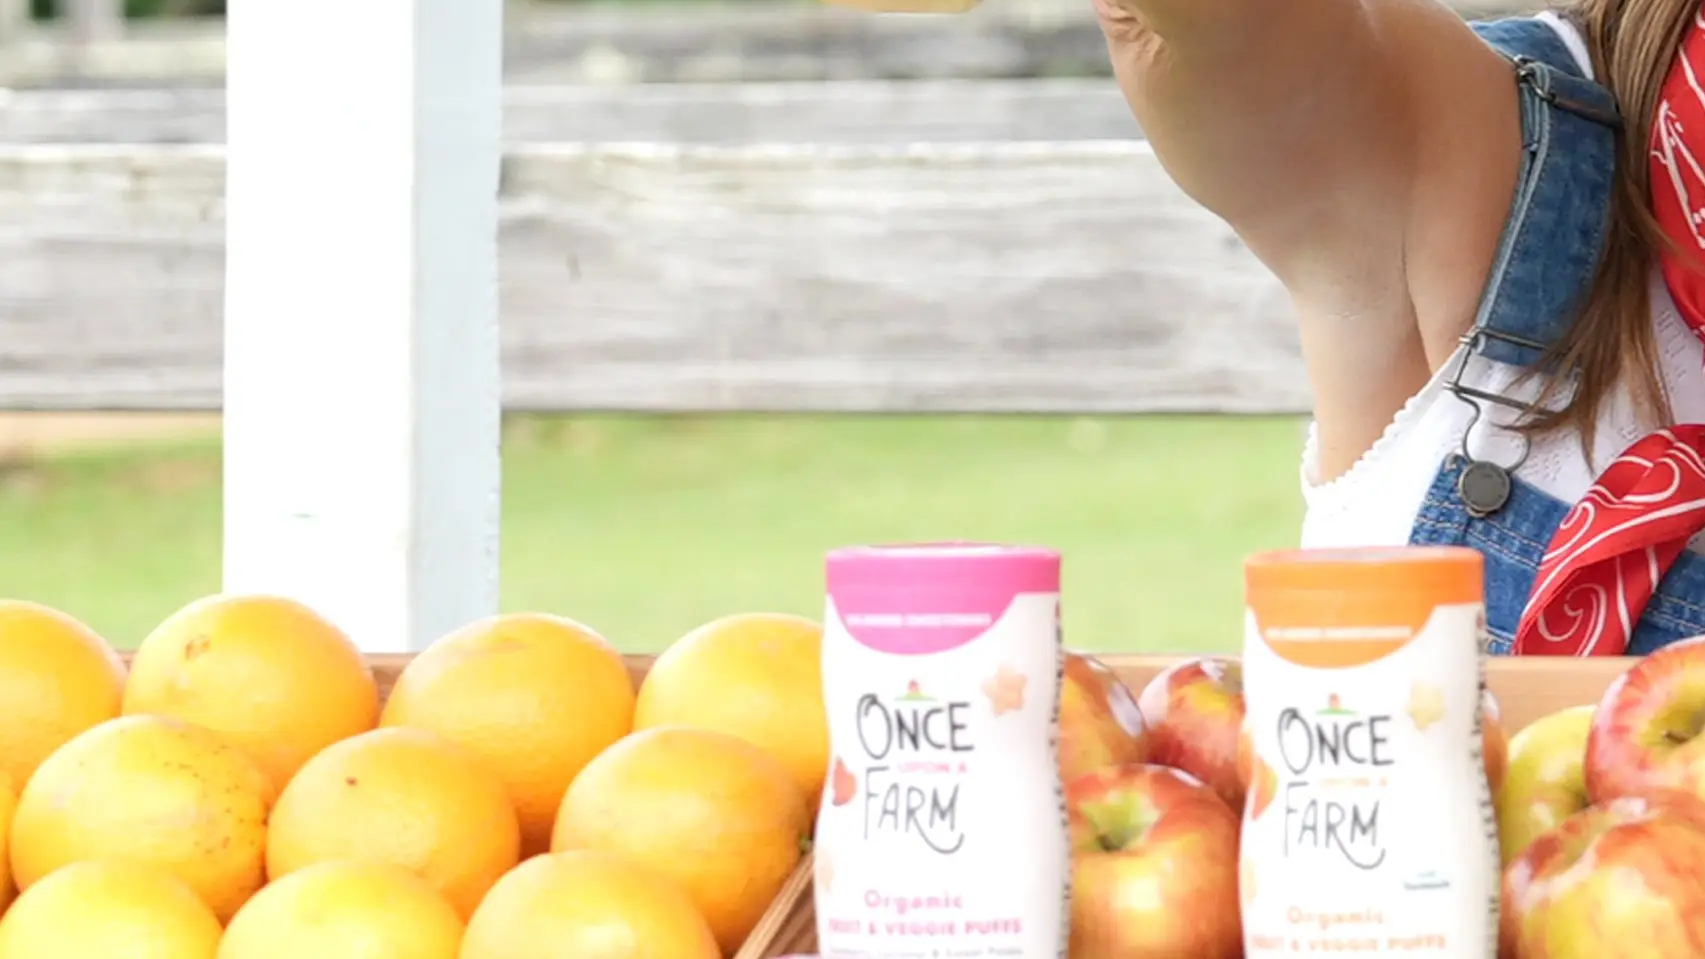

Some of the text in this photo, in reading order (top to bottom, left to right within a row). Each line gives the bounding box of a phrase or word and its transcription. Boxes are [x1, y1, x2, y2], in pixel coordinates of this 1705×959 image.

[856, 693, 975, 760] ONCE
[1277, 707, 1395, 775] ONCE
[863, 766, 965, 854] FARM
[1284, 781, 1386, 870] FARM
[863, 888, 964, 915] Organic
